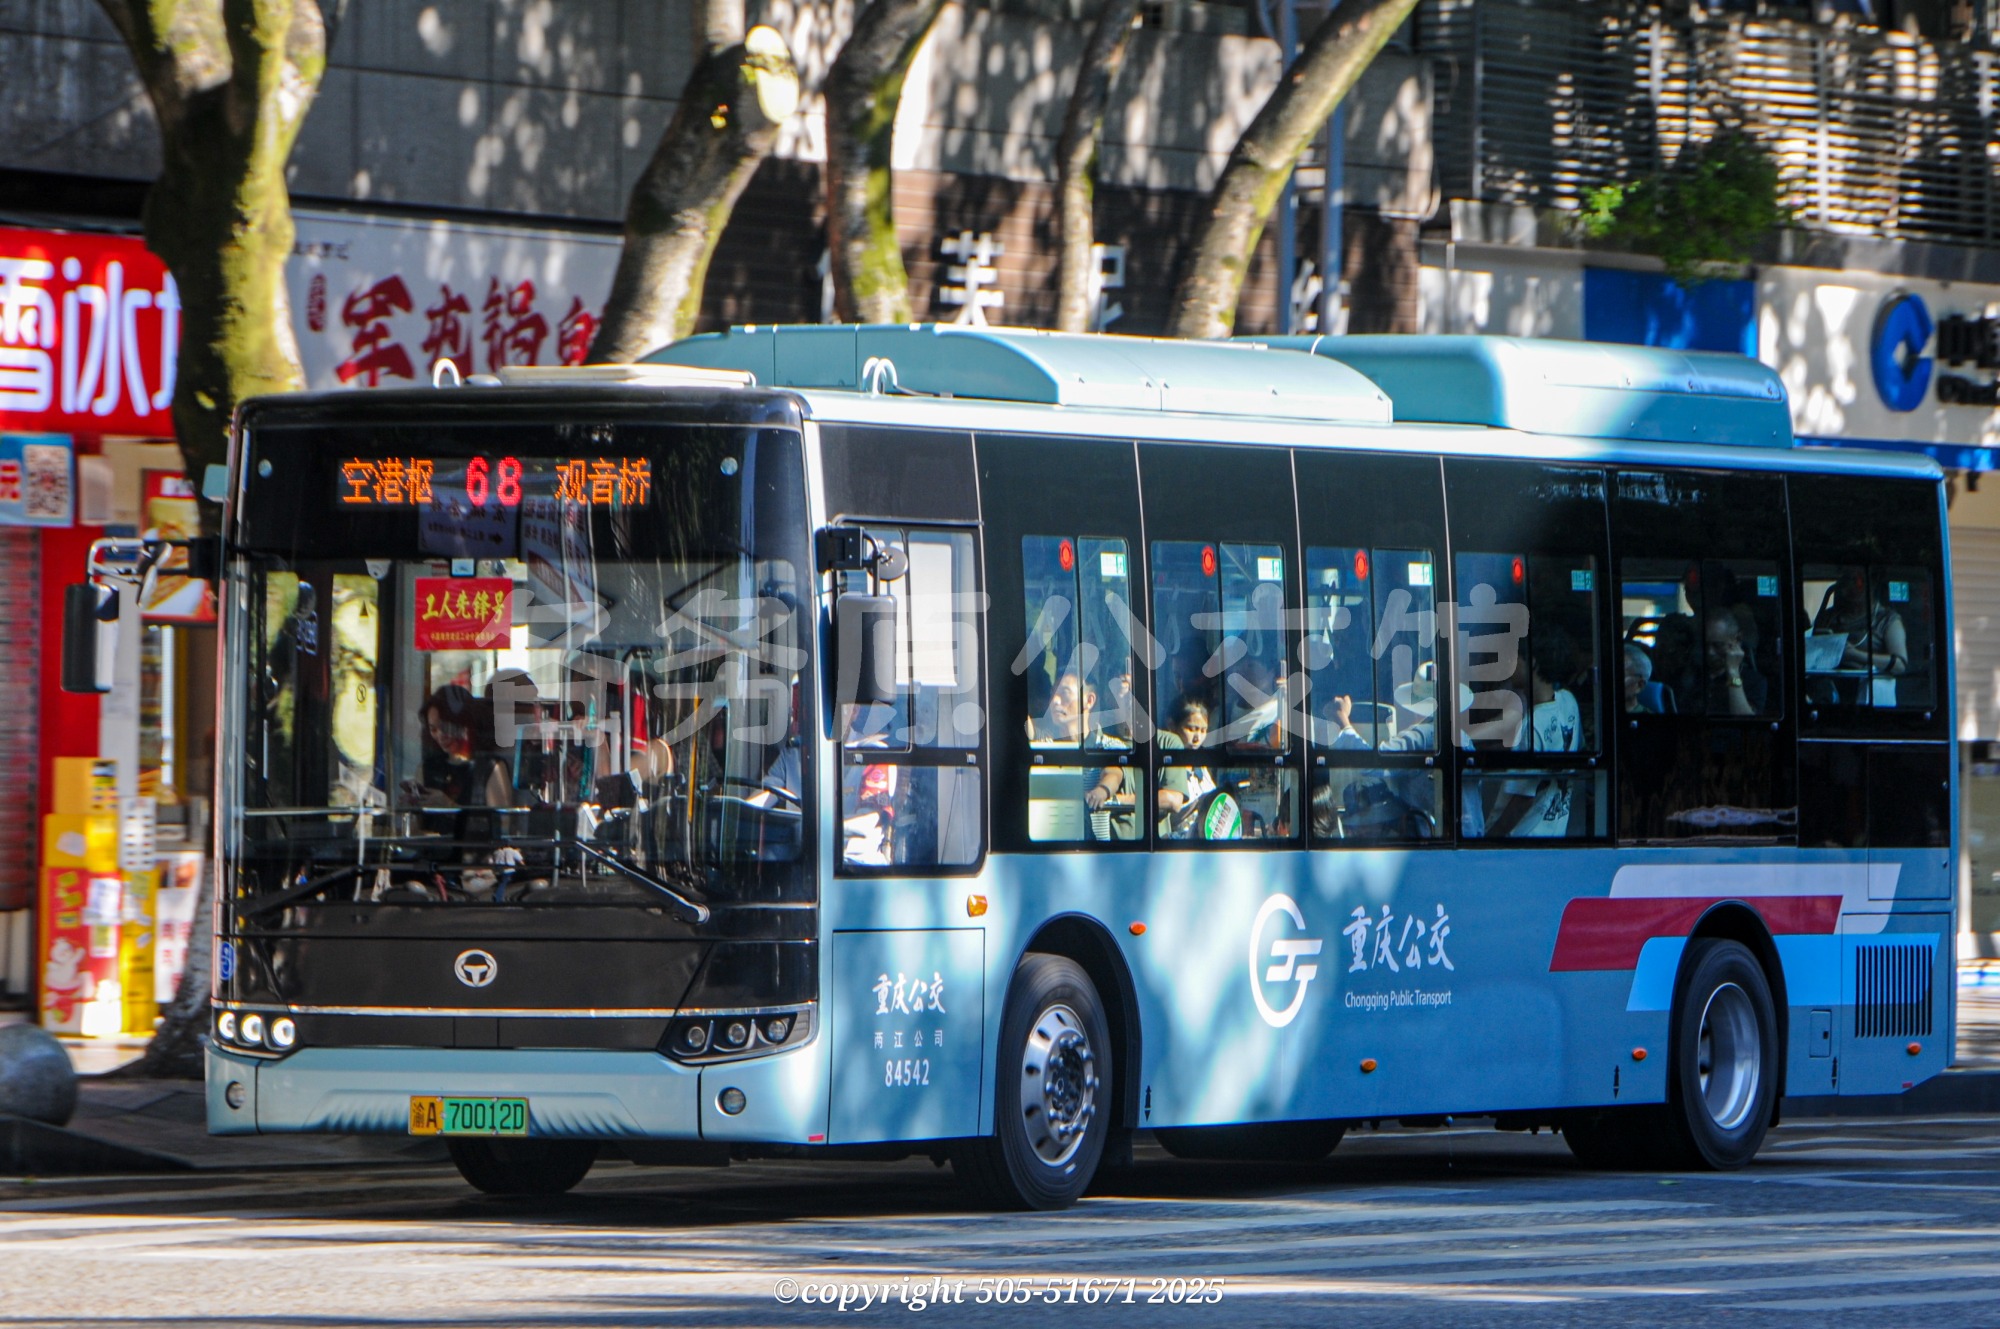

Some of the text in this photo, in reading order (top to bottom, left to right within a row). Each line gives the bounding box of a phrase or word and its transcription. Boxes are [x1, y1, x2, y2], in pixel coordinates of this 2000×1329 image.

[341, 456, 433, 505] 空港枢
[466, 456, 522, 507] 68
[554, 456, 650, 505] 观音桥
[422, 590, 505, 624] 工人先锋号
[1342, 903, 1455, 974] 重庆公交
[872, 971, 946, 1015] 重庆公交
[1345, 989, 1452, 1011] Chongqing Public Transport
[874, 1029, 943, 1049] 两江公司
[884, 1059, 930, 1087] 84542
